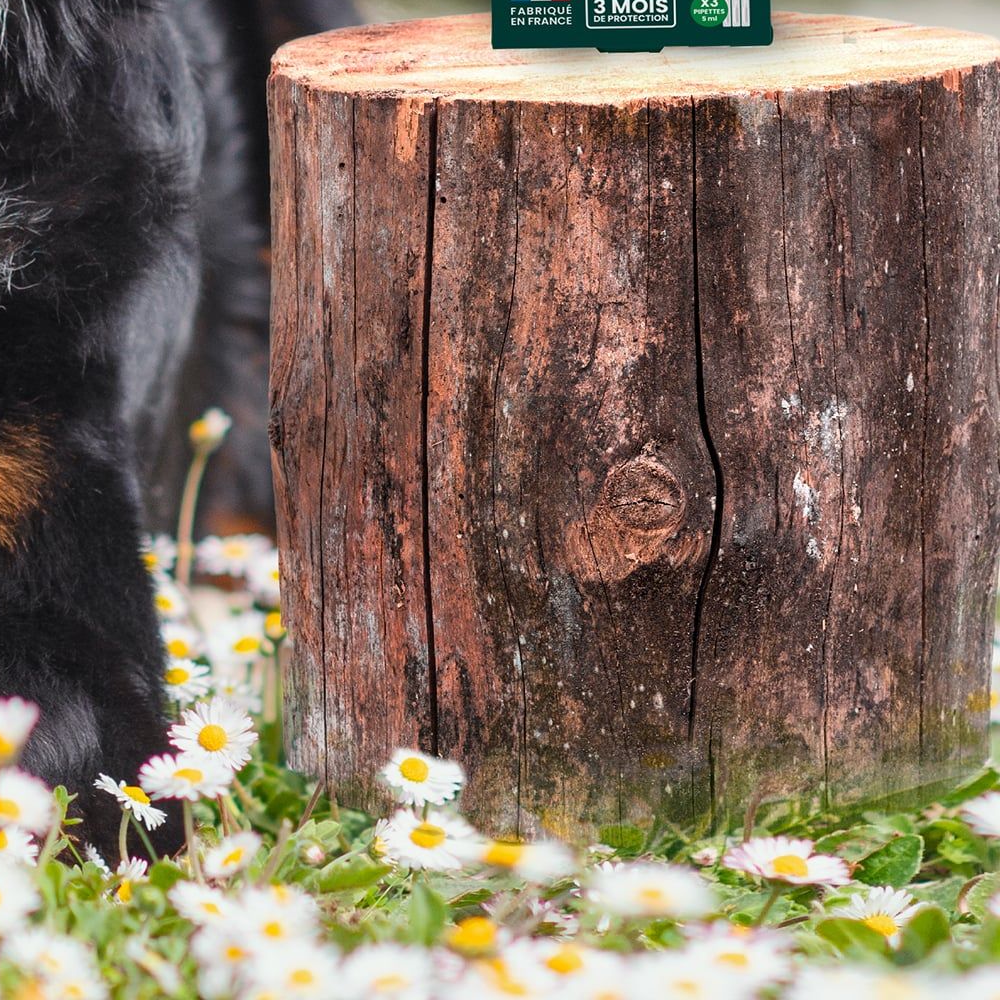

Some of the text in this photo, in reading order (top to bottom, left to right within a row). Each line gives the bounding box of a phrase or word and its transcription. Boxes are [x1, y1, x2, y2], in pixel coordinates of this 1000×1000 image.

[510, 4, 572, 16] FABRIQUÉ
[510, 16, 572, 26] EN FRANCE
[593, 14, 669, 23] DE PROTECTION
